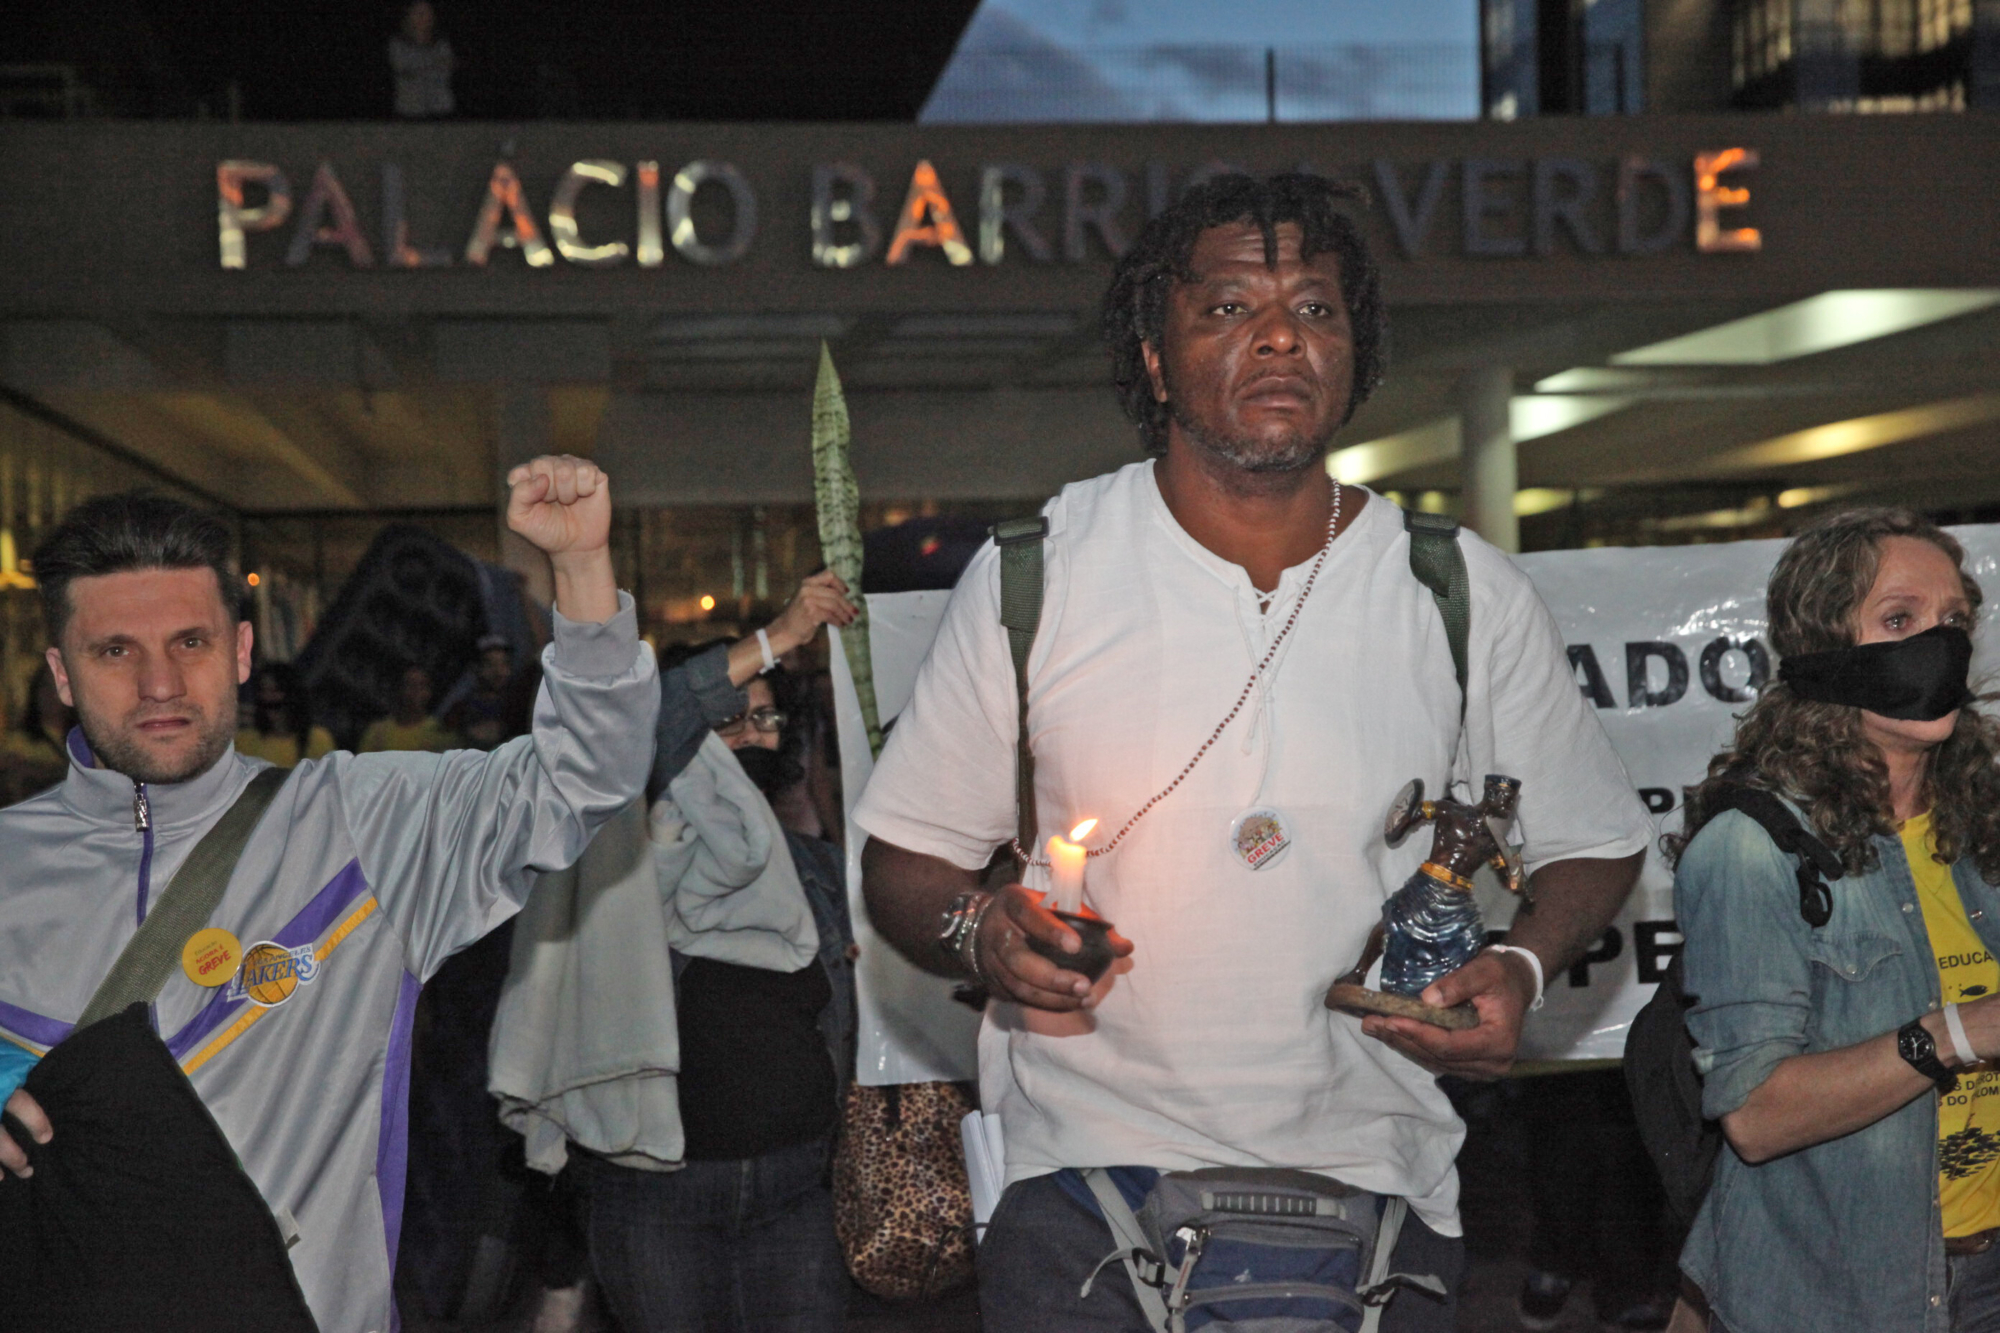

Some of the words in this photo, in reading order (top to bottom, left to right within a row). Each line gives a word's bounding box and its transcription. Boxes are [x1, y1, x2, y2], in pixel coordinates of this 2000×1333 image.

[1372, 148, 1762, 255] VERDE
[1247, 832, 1285, 864] GREVE
[198, 949, 232, 976] GREVE
[269, 946, 312, 961] ANGELES
[1938, 949, 1994, 970] EDUCA
[228, 953, 319, 997] LAKERS
[1947, 1094, 1968, 1107] DO
